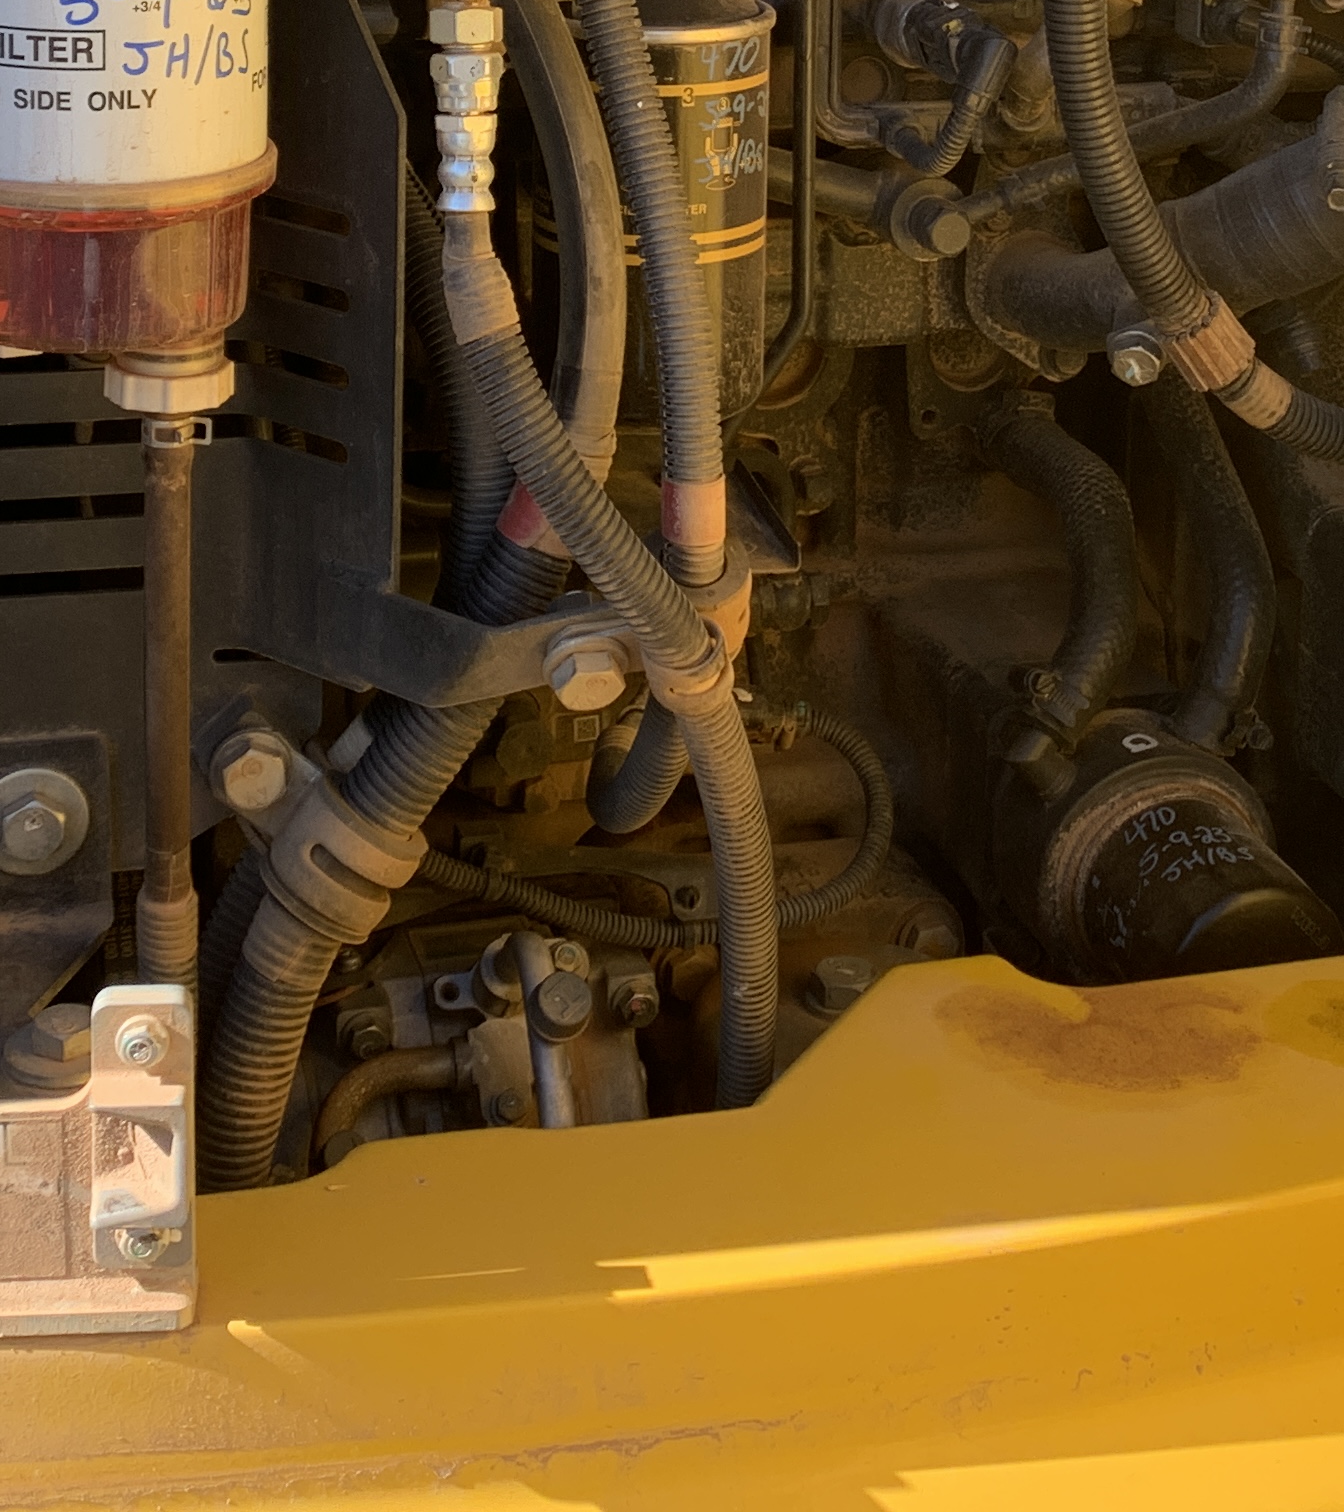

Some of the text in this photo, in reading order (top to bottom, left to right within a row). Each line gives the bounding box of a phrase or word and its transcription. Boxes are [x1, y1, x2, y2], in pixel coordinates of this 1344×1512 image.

[121, 23, 250, 85] JH/BS
[700, 36, 761, 81] 470
[13, 88, 72, 111] SIDE
[87, 88, 158, 112] ONLY
[682, 87, 695, 104] 3
[1124, 806, 1176, 845] 470
[1137, 825, 1232, 877] 5-9-23
